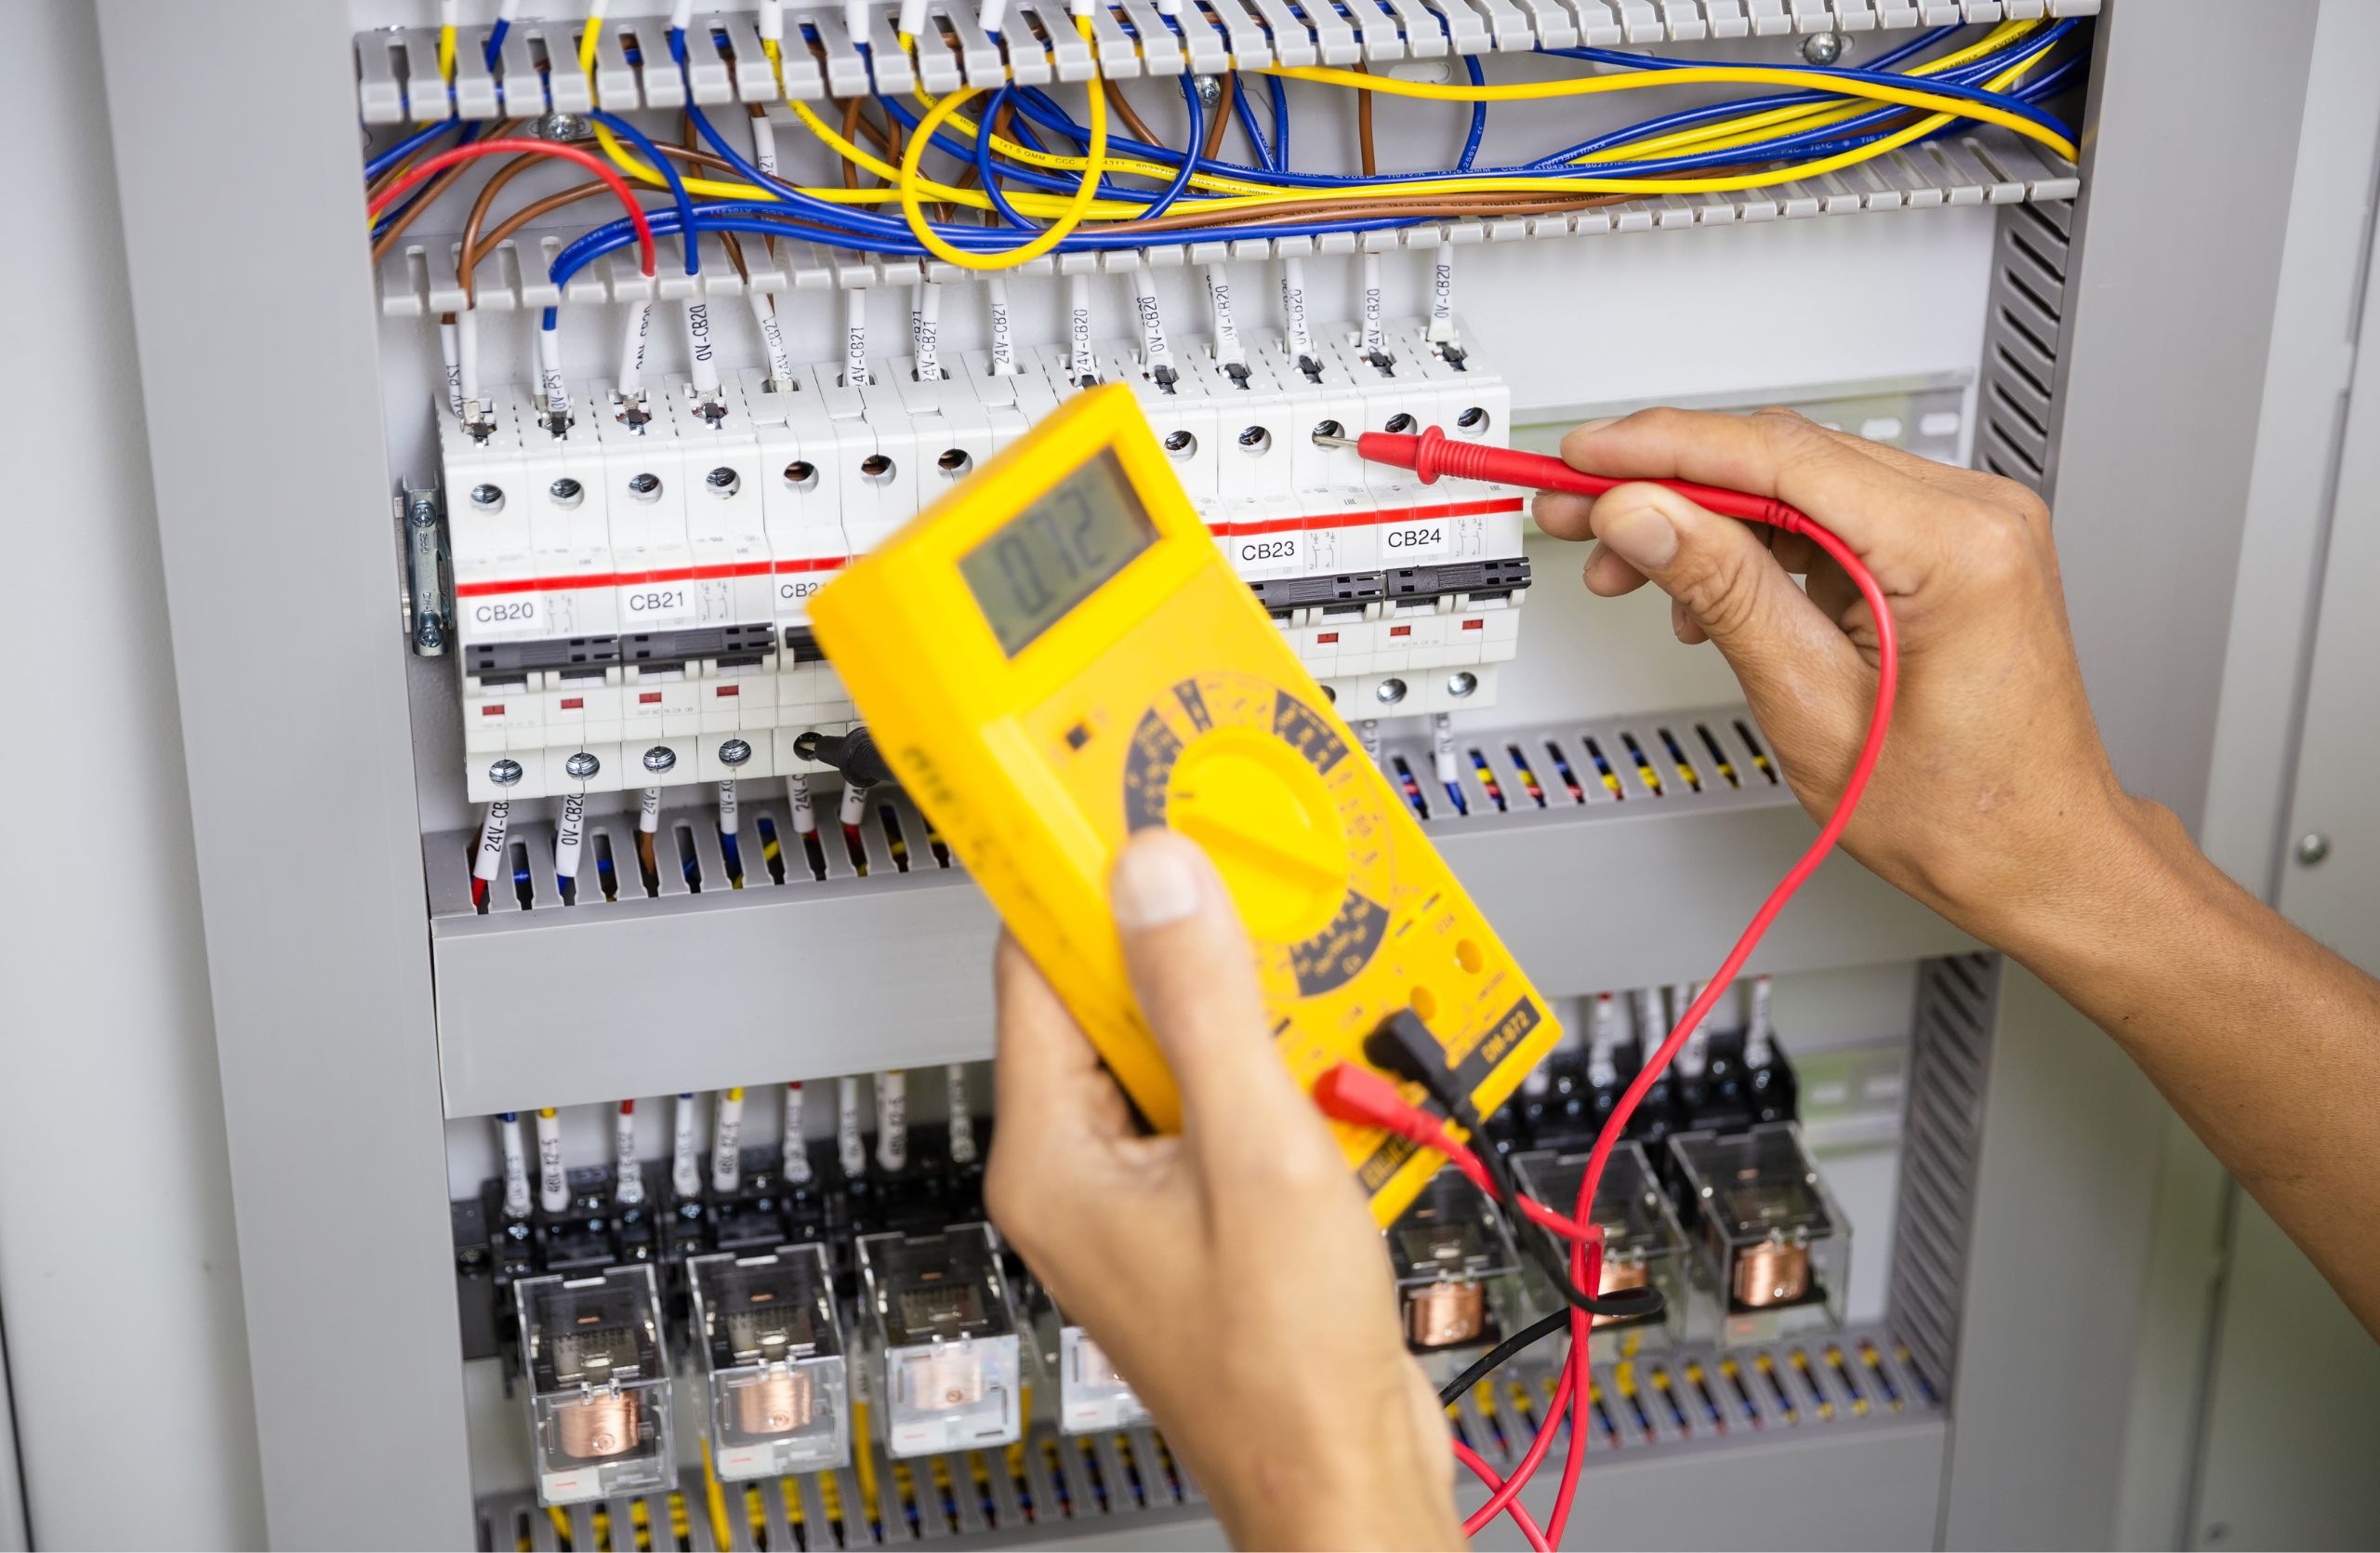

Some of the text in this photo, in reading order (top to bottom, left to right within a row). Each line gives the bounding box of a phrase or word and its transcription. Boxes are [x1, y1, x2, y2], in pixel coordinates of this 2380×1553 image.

[1436, 264, 1450, 319] 0V-CB20
[692, 304, 713, 361] 0V-CB20
[993, 303, 1009, 365] 24V-CB21
[1075, 309, 1089, 373] 24V-CB20
[1144, 297, 1165, 352] 0V-CB20
[851, 326, 865, 386] 4V-CB21
[1241, 539, 1296, 562] CB23
[1388, 526, 1442, 550] CB24
[476, 602, 535, 623] CB20
[629, 591, 684, 613] CB21
[780, 583, 826, 600] CB2
[484, 801, 509, 852] 24V-CB
